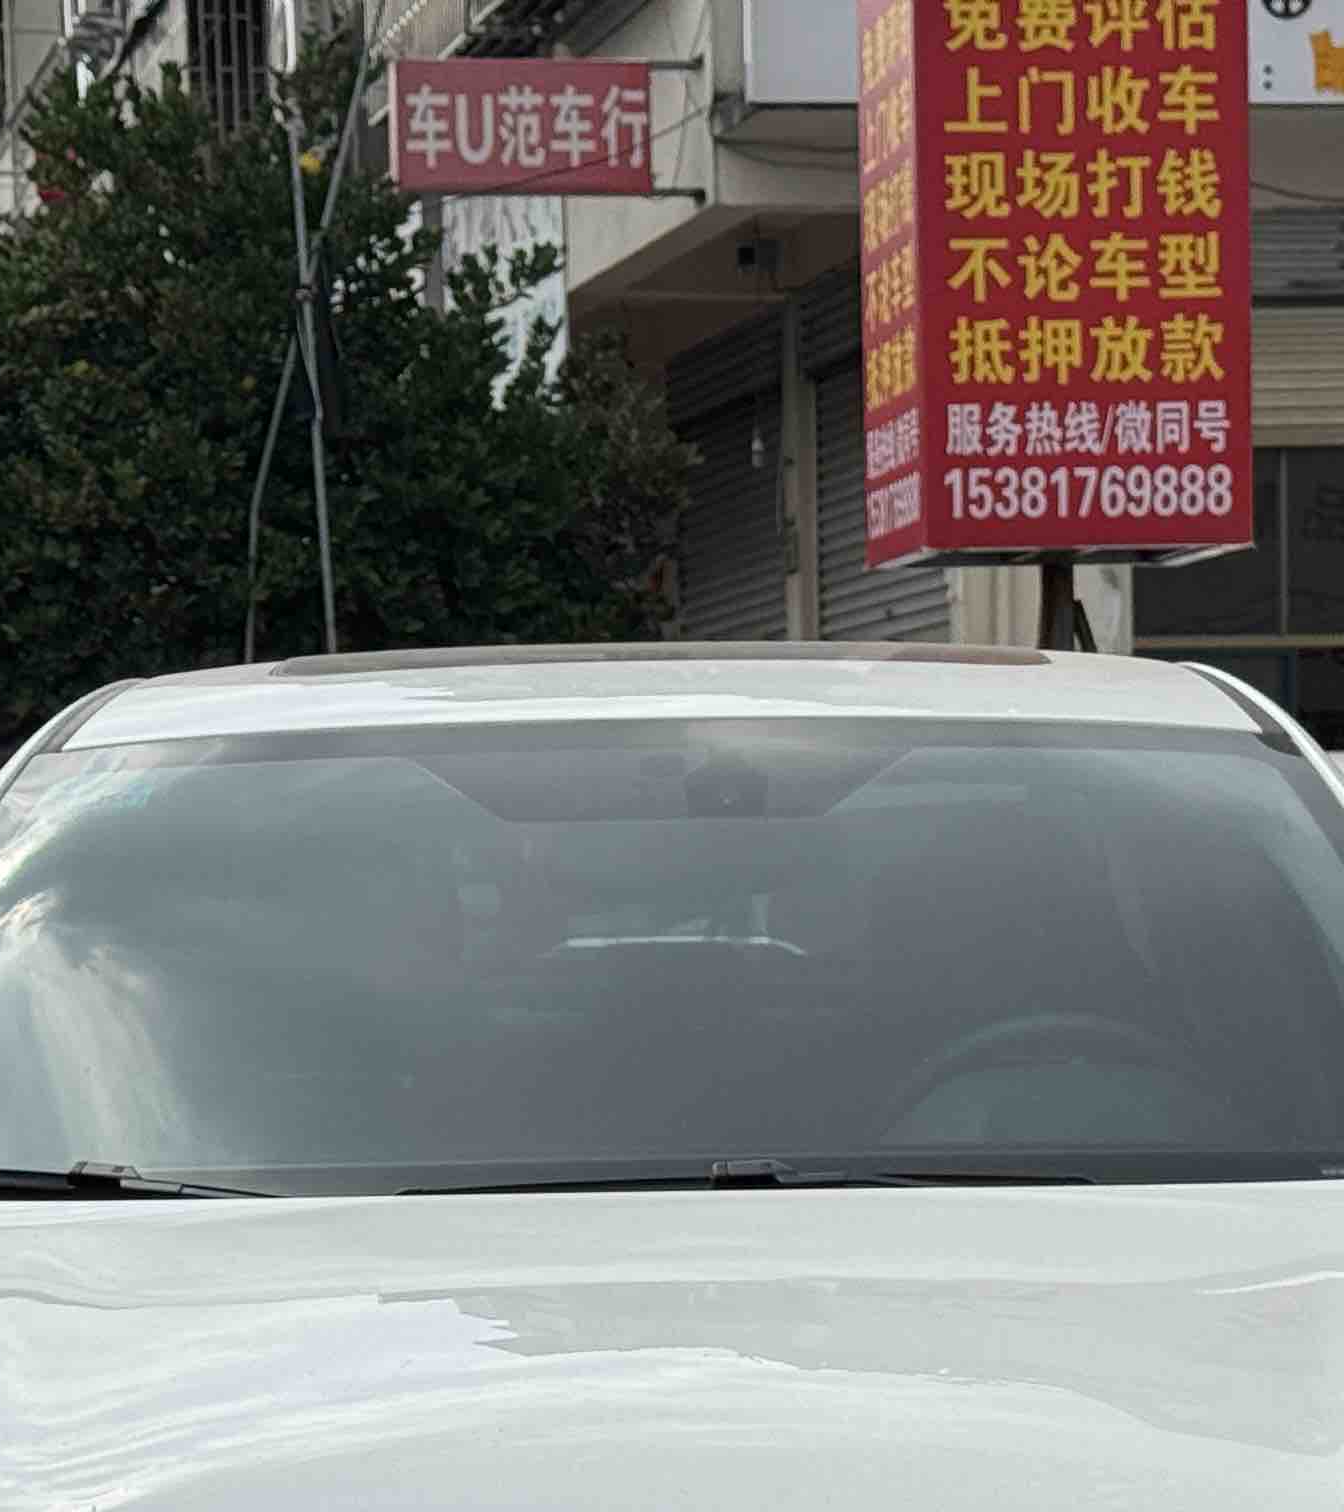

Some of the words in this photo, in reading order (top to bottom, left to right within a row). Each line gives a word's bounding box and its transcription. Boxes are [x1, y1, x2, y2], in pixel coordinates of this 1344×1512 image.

[943, 0, 1219, 52] 免费评估
[404, 84, 648, 168] 车U范车行
[943, 65, 1220, 135] 上门收车
[943, 149, 1222, 219] 现场打钱
[946, 232, 1223, 302] 不论车型
[949, 313, 1225, 384] 抵押放款
[945, 400, 1230, 455] 服务热线/微同号
[943, 464, 1233, 519] 15381769888
